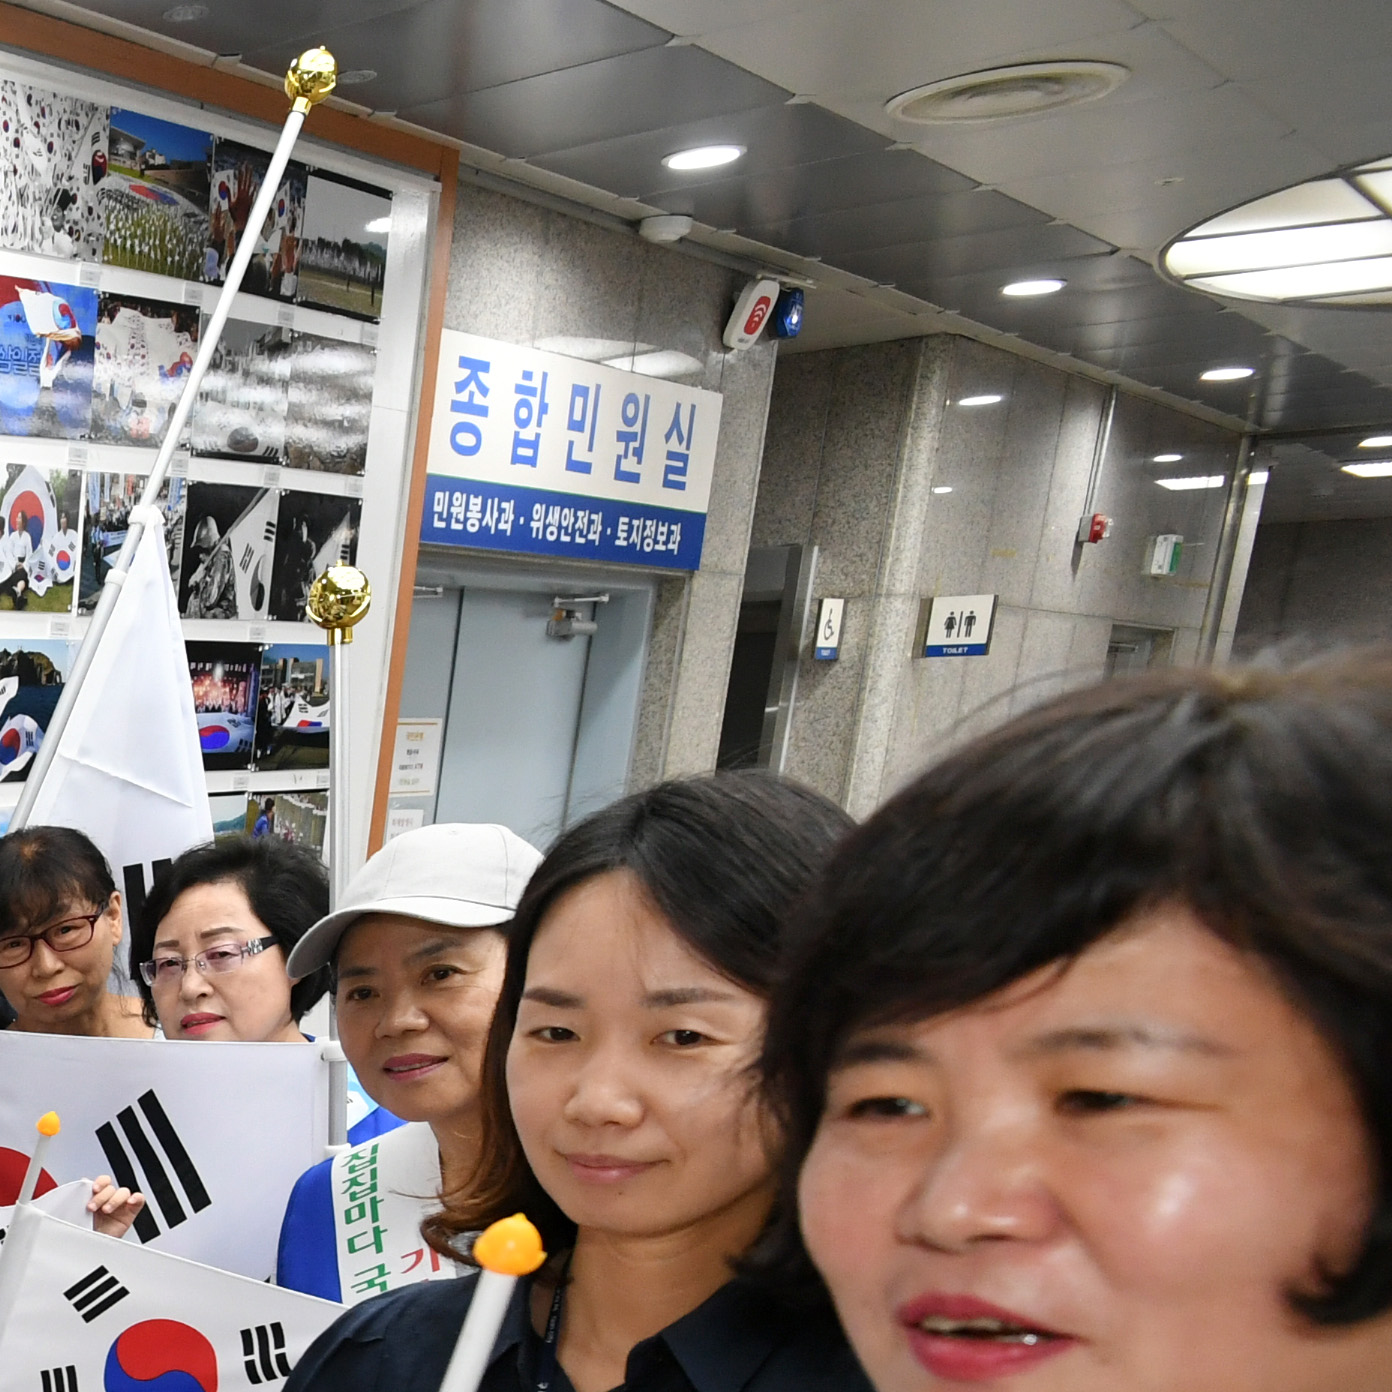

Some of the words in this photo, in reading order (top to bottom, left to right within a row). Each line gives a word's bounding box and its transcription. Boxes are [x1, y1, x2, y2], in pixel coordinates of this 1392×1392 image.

[450, 355, 697, 491] 종합민원실
[433, 491, 514, 535] 민원봉사과
[530, 503, 603, 545] 위생안전과
[615, 516, 681, 555] 토지정보과
[942, 646, 969, 655] TOILET
[341, 1143, 388, 1254] 집집마다
[401, 1248, 440, 1275] 기
